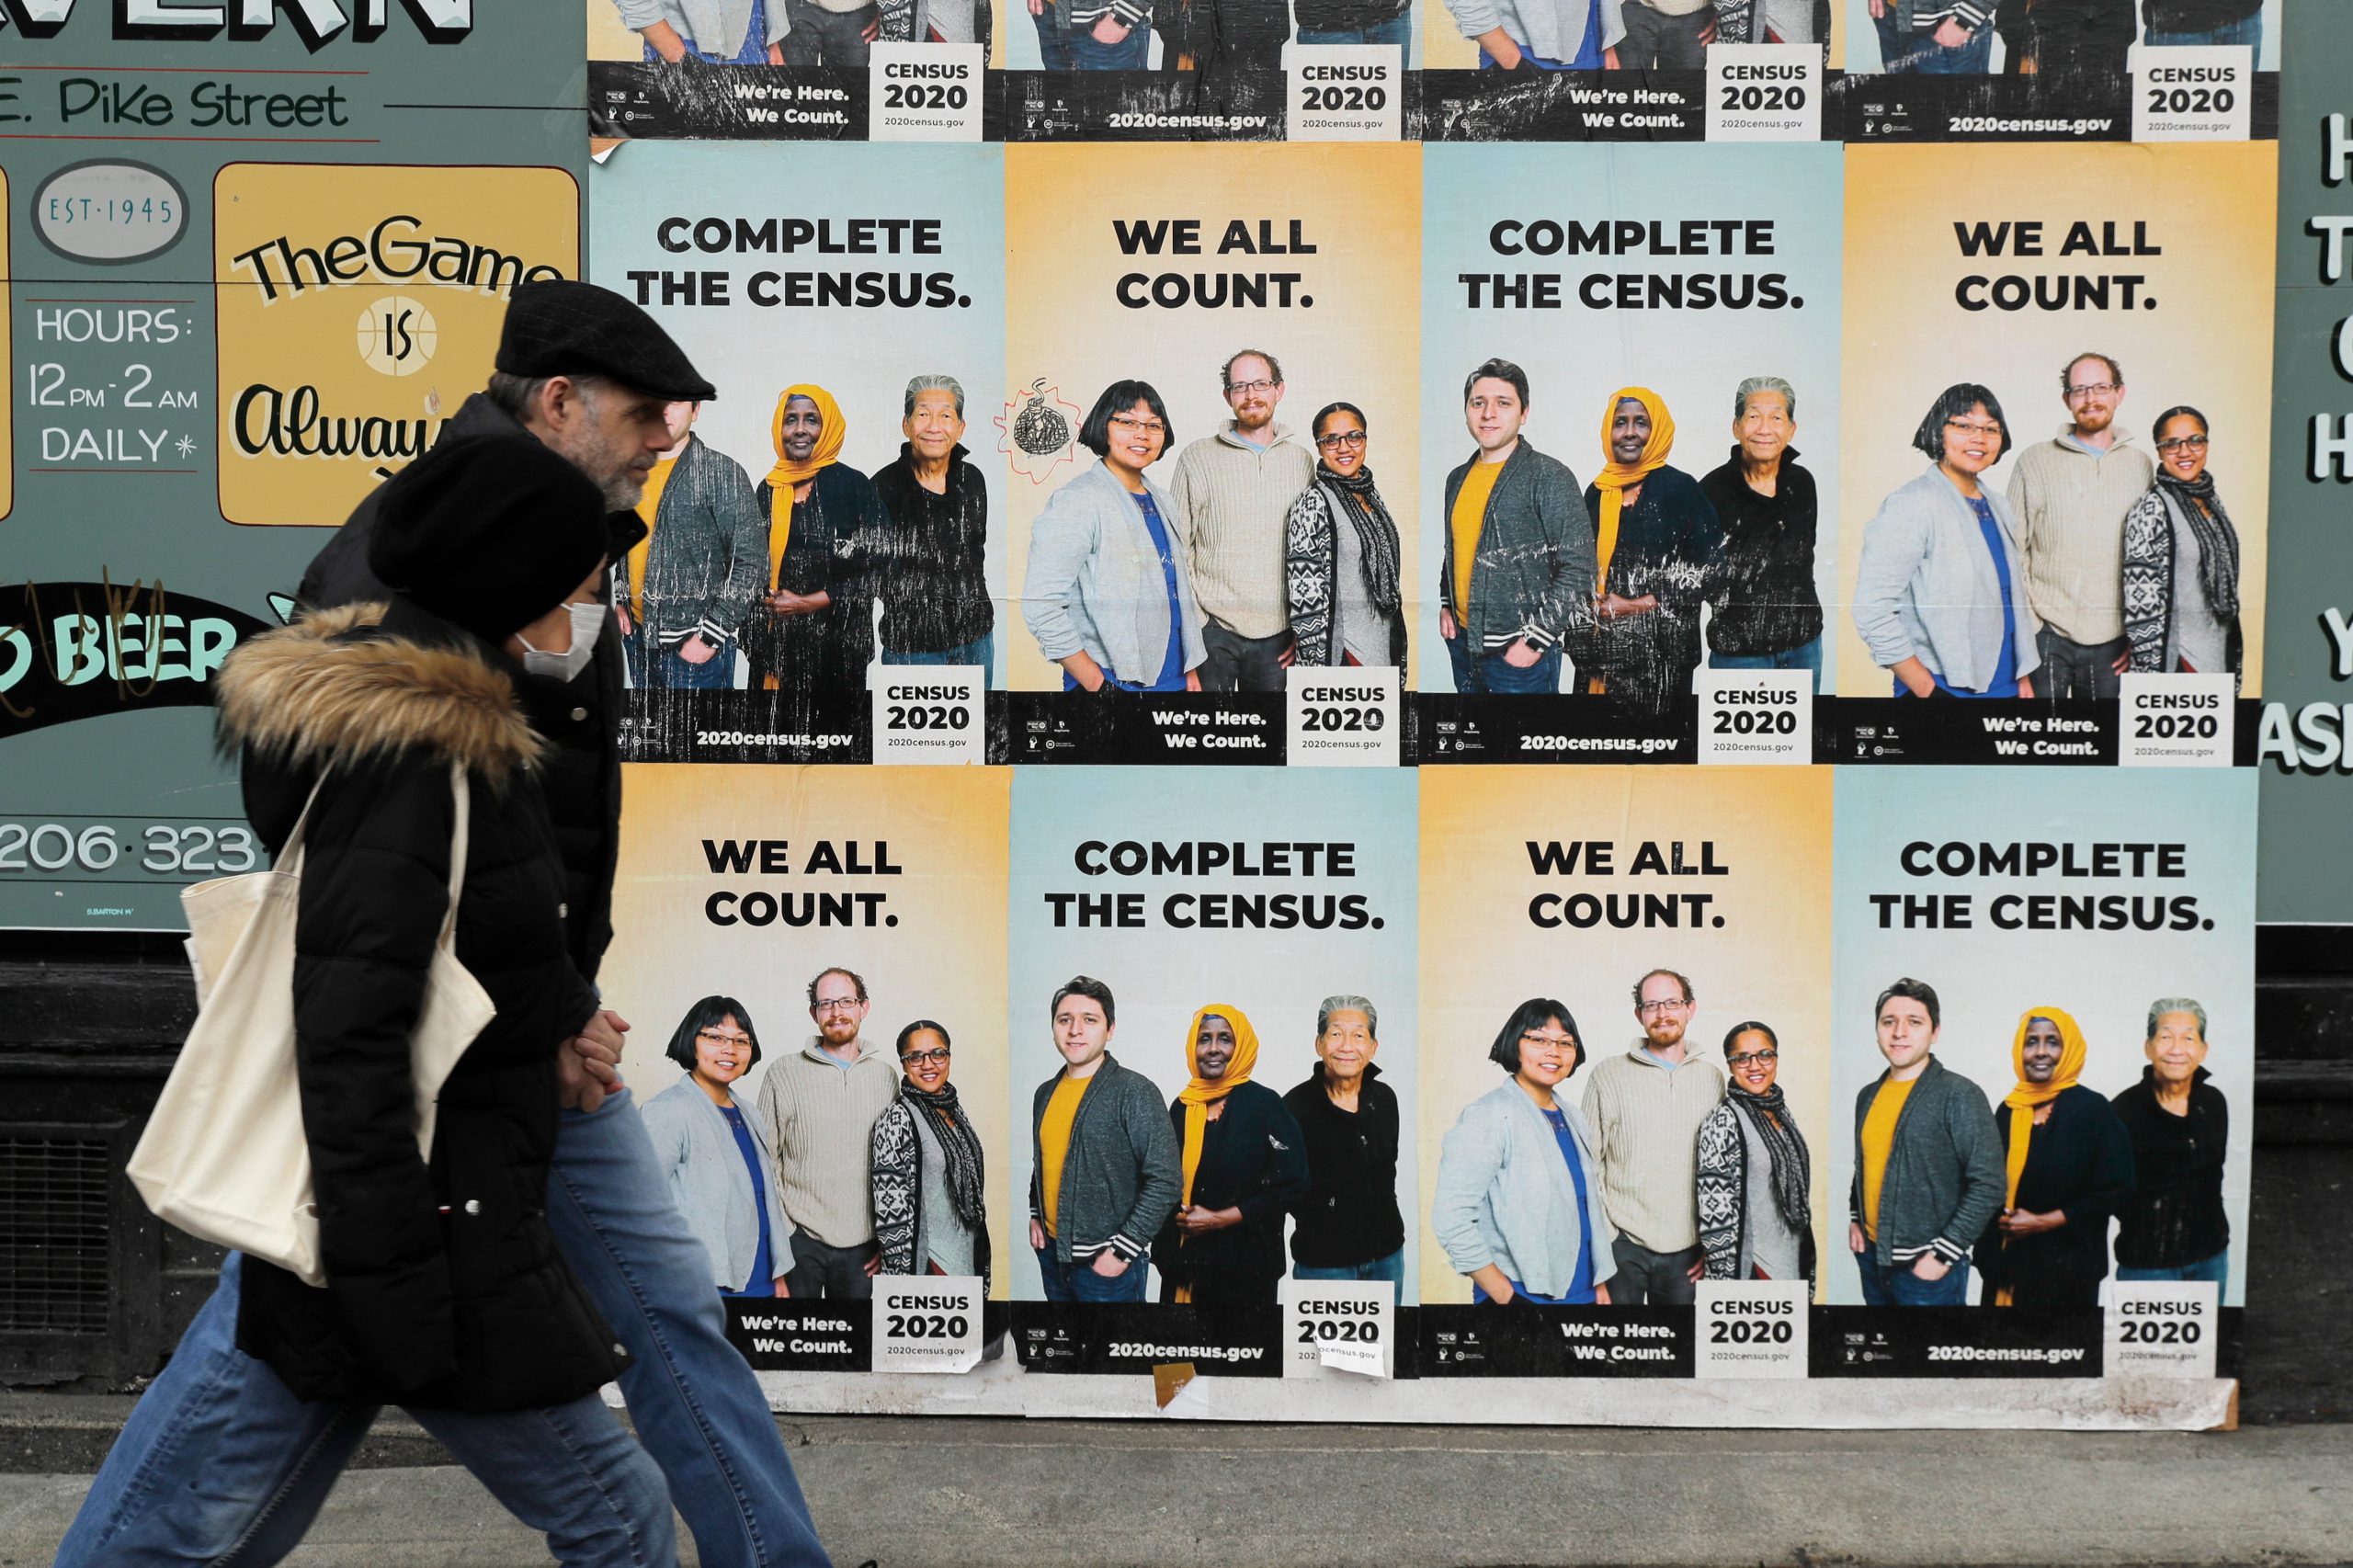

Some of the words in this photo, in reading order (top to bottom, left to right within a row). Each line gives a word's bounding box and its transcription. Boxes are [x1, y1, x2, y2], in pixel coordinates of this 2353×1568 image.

[885, 63, 968, 79] CENSUS
[1302, 66, 1386, 80] CENSUS
[1722, 65, 1806, 80] CENSUS
[2149, 68, 2234, 82] CENSUS
[734, 85, 791, 100] We're
[798, 86, 848, 100] Here.
[884, 85, 967, 109] 2020
[1302, 86, 1385, 110] 2020
[1570, 89, 1628, 104] We're
[1634, 90, 1685, 104] Here.
[1722, 86, 1805, 110] 2020
[2149, 89, 2234, 112] 2020
[190, 82, 349, 128] Street
[746, 108, 779, 122] We
[785, 109, 848, 123] Count.
[885, 118, 964, 128] 2020census.gov
[1109, 114, 1267, 130] 2020census.gov
[1583, 113, 1614, 127] We
[1620, 113, 1685, 127] Count.
[1722, 119, 1802, 129] 2020census.gov
[1302, 120, 1382, 129] 2020census.gov
[1949, 118, 2111, 134] 2020census.gov
[2148, 123, 2230, 131] 2020census.gov
[657, 218, 941, 254] COMPLETE
[1112, 221, 1200, 254] WE
[1217, 220, 1316, 254] ALL
[1490, 220, 1774, 256] COMPLETE
[1954, 222, 2042, 256] WE
[2060, 222, 2161, 256] ALL
[233, 235, 369, 300] The
[627, 271, 730, 306] THE
[747, 271, 971, 308] CENSUS.
[1117, 273, 1313, 308] COUNT.
[1459, 274, 1561, 308] THE
[1579, 274, 1803, 309] CENSUS.
[1956, 276, 2156, 311] COUNT.
[37, 309, 191, 343] HOURS:
[385, 309, 413, 360] IS
[53, 613, 237, 686] BEER
[888, 687, 970, 699] CENSUS
[1302, 687, 1384, 701] CENSUS
[1714, 690, 1797, 704] CENSUS
[2136, 695, 2218, 709] CENSUS
[887, 706, 969, 730] 2020
[1153, 710, 1210, 724] We're
[1216, 711, 1266, 724] Here.
[1302, 708, 1384, 731] 2020
[1713, 710, 1796, 734] 2020
[1983, 718, 2041, 732] We're
[2047, 718, 2099, 732] Here.
[2135, 715, 2217, 738] 2020
[697, 732, 853, 749] 2020census.gov
[889, 739, 966, 748] 2020census.gov
[1165, 734, 1197, 747] We
[1202, 734, 1266, 747] Count.
[1302, 741, 1381, 749] 2020census.gov
[1521, 736, 1677, 753] 2020census.gov
[1714, 744, 1793, 753] 2020census.gov
[1995, 741, 2029, 755] We
[2033, 741, 2098, 755] Count.
[2135, 748, 2214, 757] 2020census.gov
[701, 840, 789, 874] WE
[804, 841, 902, 874] ALL
[1074, 841, 1355, 876] COMPLETE
[1526, 842, 1613, 875] WE
[1629, 842, 1728, 875] ALL
[1901, 842, 2185, 877] COMPLETE
[705, 892, 898, 926] COUNT.
[1045, 893, 1145, 927] THE
[1163, 893, 1384, 929] CENSUS.
[1529, 893, 1724, 928] COUNT.
[1870, 895, 1972, 928] THE
[1990, 895, 2214, 931] CENSUS.
[888, 1296, 969, 1310] CENSUS
[1299, 1301, 1380, 1315] CENSUS
[1711, 1301, 1792, 1314] CENSUS
[2122, 1302, 2201, 1315] CENSUS
[742, 1316, 797, 1330] We're
[803, 1317, 852, 1331] Here.
[887, 1315, 968, 1338] 2020
[1298, 1321, 1379, 1343] 2020
[1562, 1324, 1619, 1337] We're
[1624, 1324, 1675, 1337] Here.
[1711, 1321, 1792, 1343] 2020
[2120, 1322, 2200, 1344] 2020
[754, 1339, 785, 1352] We
[790, 1339, 852, 1353] Count.
[888, 1346, 964, 1356] 2020census.gov
[1109, 1343, 1263, 1361] 2020census.gov
[1574, 1346, 1606, 1359] We
[1611, 1346, 1675, 1360] Count.
[1928, 1346, 2084, 1363] 2020census.gov
